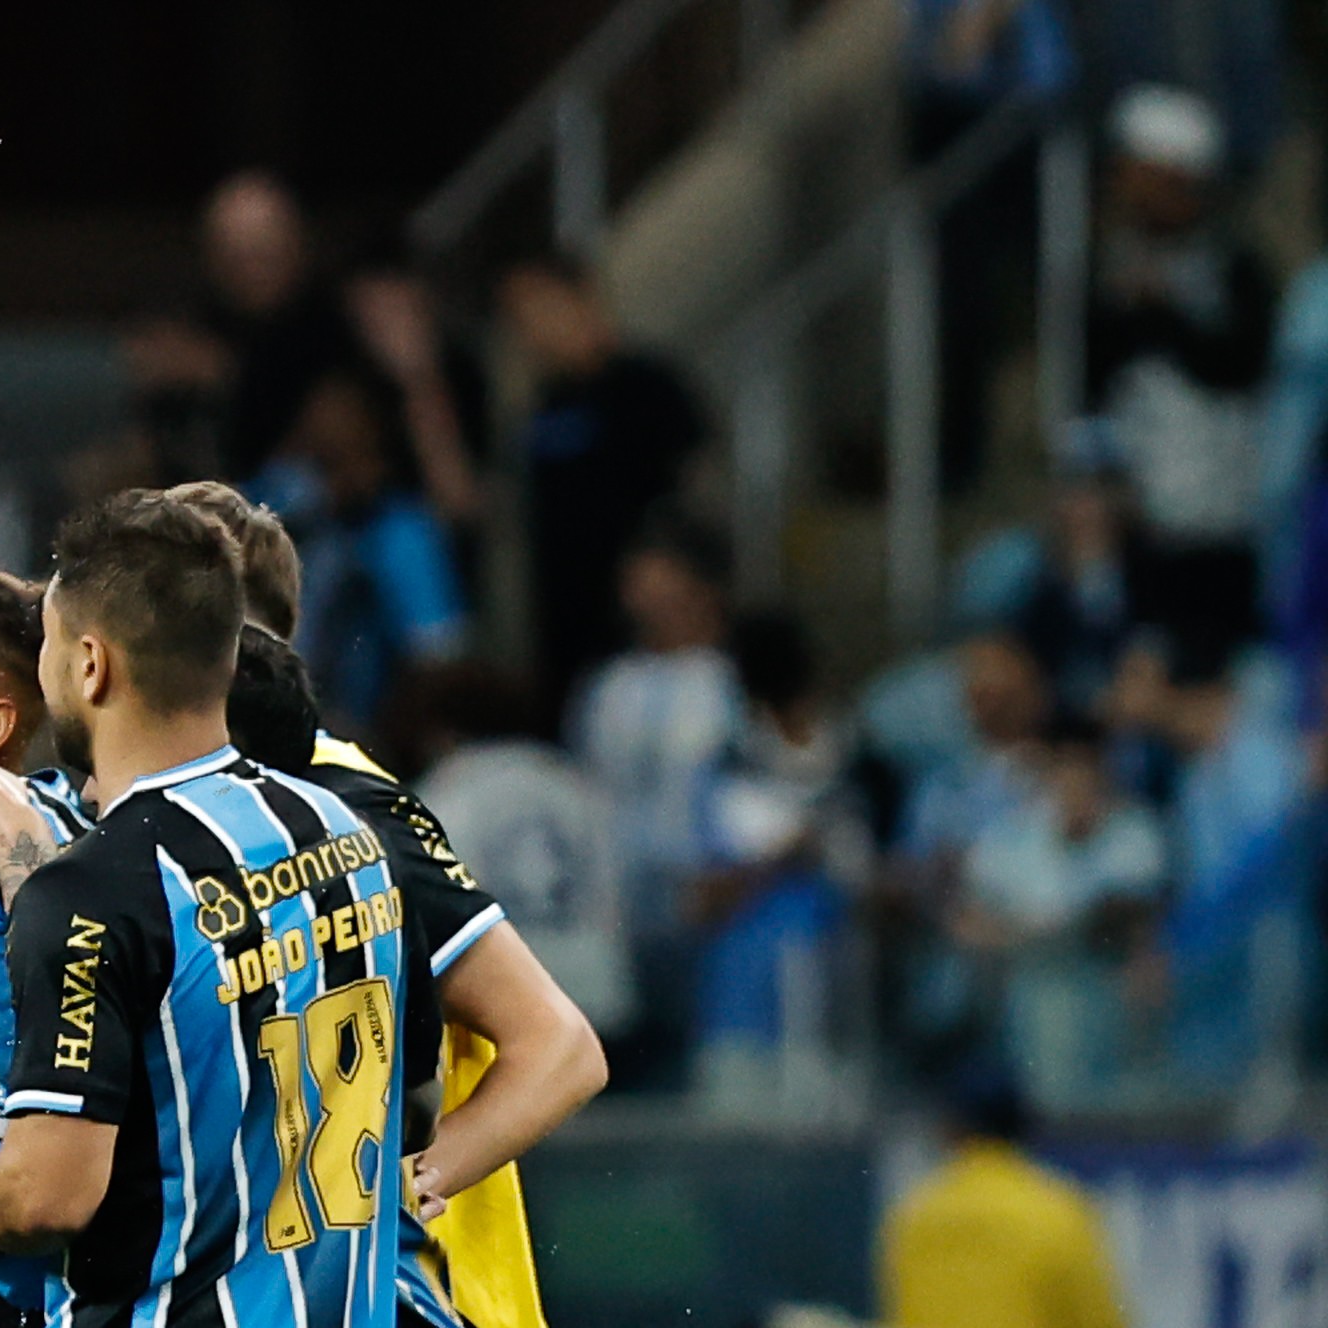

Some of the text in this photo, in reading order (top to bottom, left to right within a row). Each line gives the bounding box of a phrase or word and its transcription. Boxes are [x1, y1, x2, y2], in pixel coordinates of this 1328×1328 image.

[237, 822, 387, 911] banrisul
[310, 886, 404, 959] PEDRO
[55, 913, 107, 1072] HAVAN
[257, 975, 394, 1254] 18
